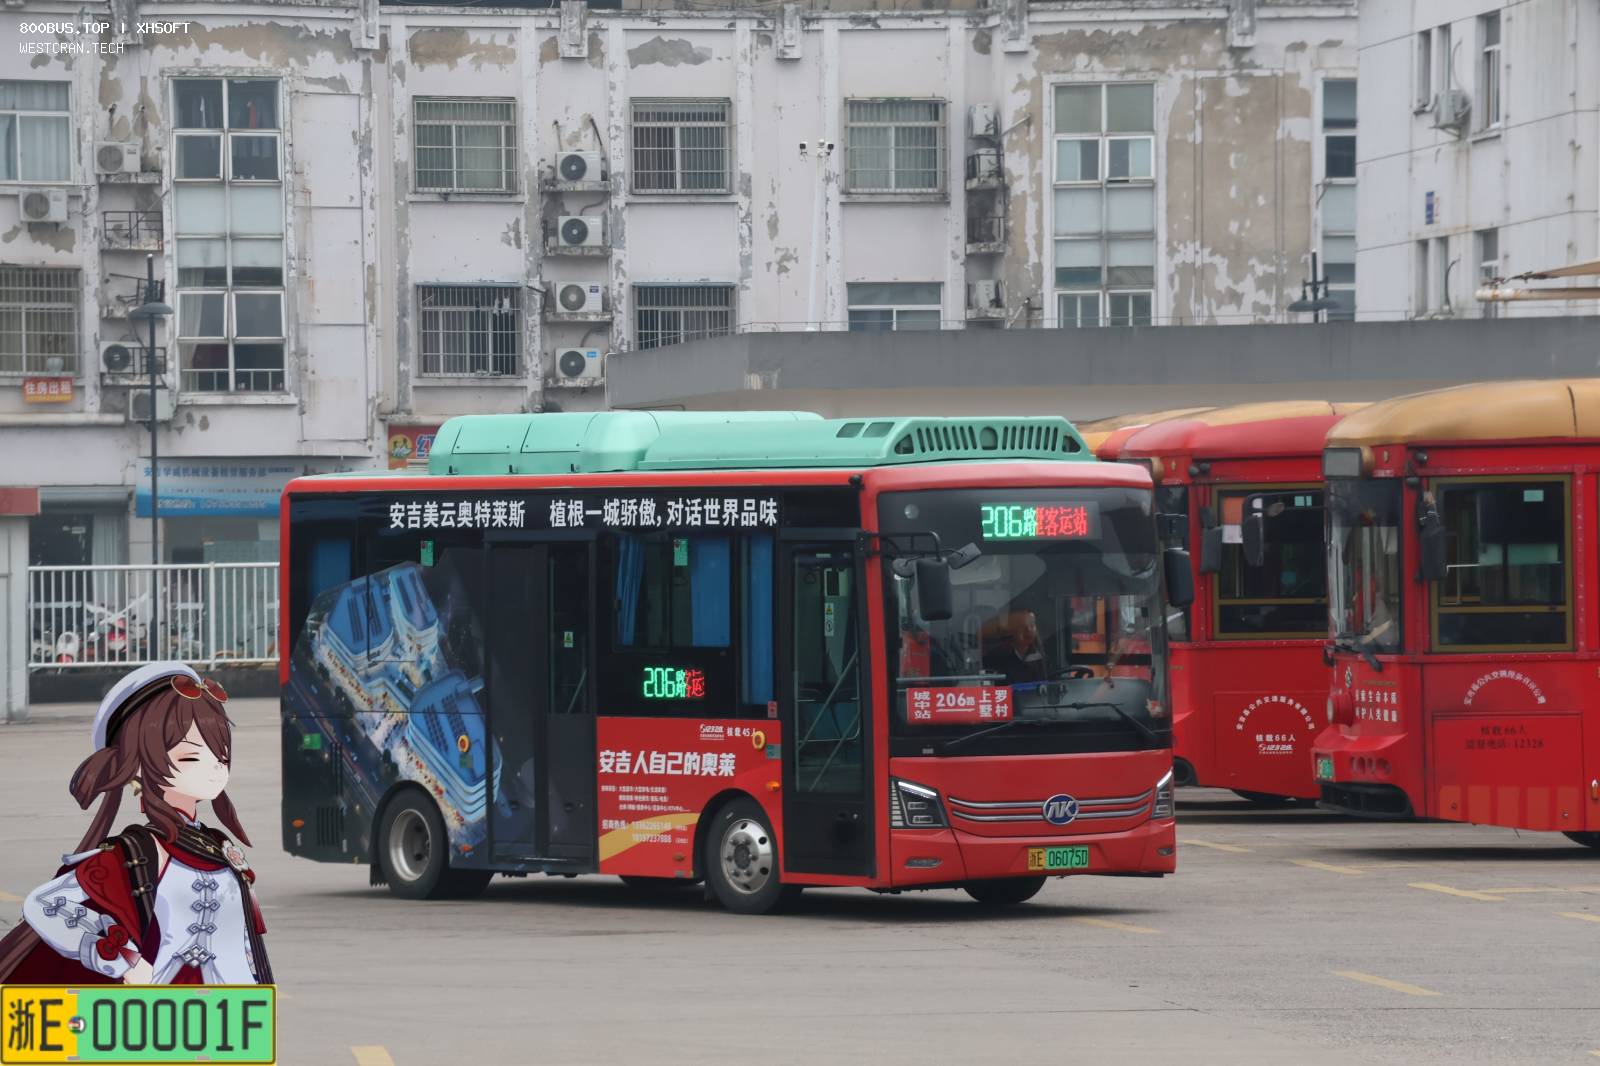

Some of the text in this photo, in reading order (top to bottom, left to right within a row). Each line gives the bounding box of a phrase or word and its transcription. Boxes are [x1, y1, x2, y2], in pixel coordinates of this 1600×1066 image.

[25, 381, 72, 395] 住房出租
[389, 500, 526, 529] 安吉美云奥特莱斯
[914, 691, 931, 719] 城中站
[599, 750, 737, 777] 安吉人自己的奥莱
[1048, 849, 1088, 867] 06075D
